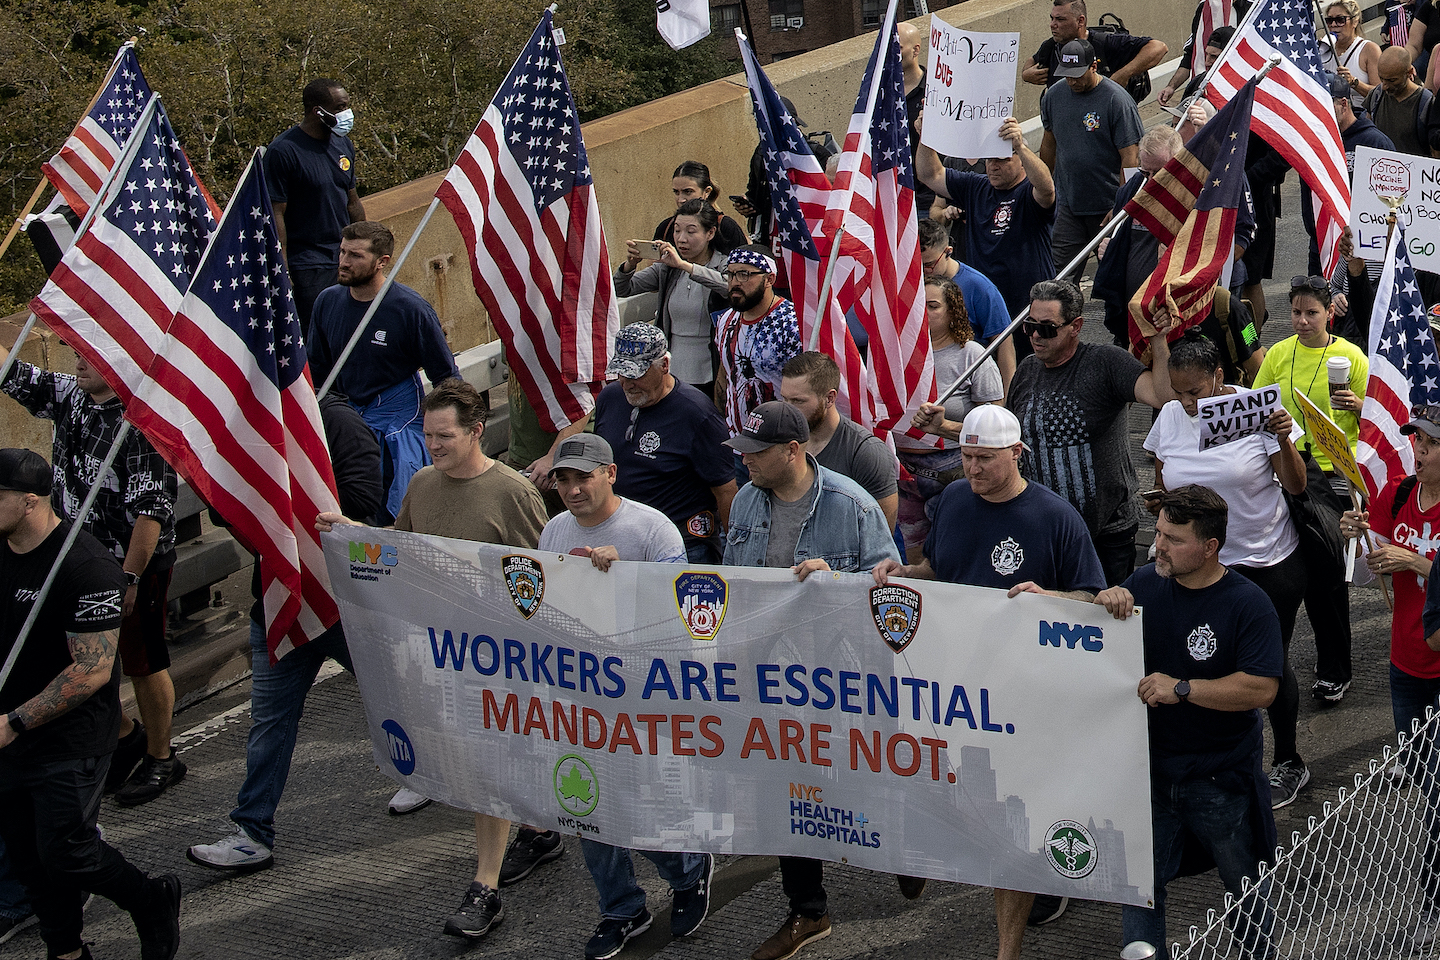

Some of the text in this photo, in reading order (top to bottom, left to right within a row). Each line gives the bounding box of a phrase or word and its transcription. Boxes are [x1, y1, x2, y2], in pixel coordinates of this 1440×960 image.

[930, 24, 942, 49] NOT
[934, 54, 953, 87] but
[1375, 161, 1405, 175] STOP
[1372, 173, 1403, 184] VACCINE
[1408, 237, 1435, 256] GO
[1201, 389, 1278, 420] STAND
[1207, 407, 1275, 435] WITH
[349, 541, 398, 567] NYC
[509, 556, 533, 568] POLICE
[350, 564, 391, 576] Department of
[350, 573, 379, 583] Education
[503, 564, 542, 580] DEPARTMENT
[678, 575, 723, 592] FIRE DEPARTMENT
[15, 588, 41, 602] 1776
[506, 578, 544, 614] CITY OF NEW YORK
[872, 587, 919, 603] CORRECTION
[872, 594, 919, 609] DEPARTMENT
[93, 607, 109, 616] GS
[874, 610, 919, 646] CITY OF NEW YORK
[1038, 620, 1104, 653] NYC
[427, 626, 1016, 735] WORKERS ARE ESSENTIAL.
[482, 688, 957, 785] MANDATES ARE NOT.
[789, 782, 823, 804] NYC
[557, 816, 601, 835] NYC Parks
[790, 817, 881, 849] HOSPITALS
[1052, 821, 1088, 835] NEW YORK CITY
[1046, 850, 1069, 875] DEPARTMENT
[1075, 856, 1096, 877] SANITATION
